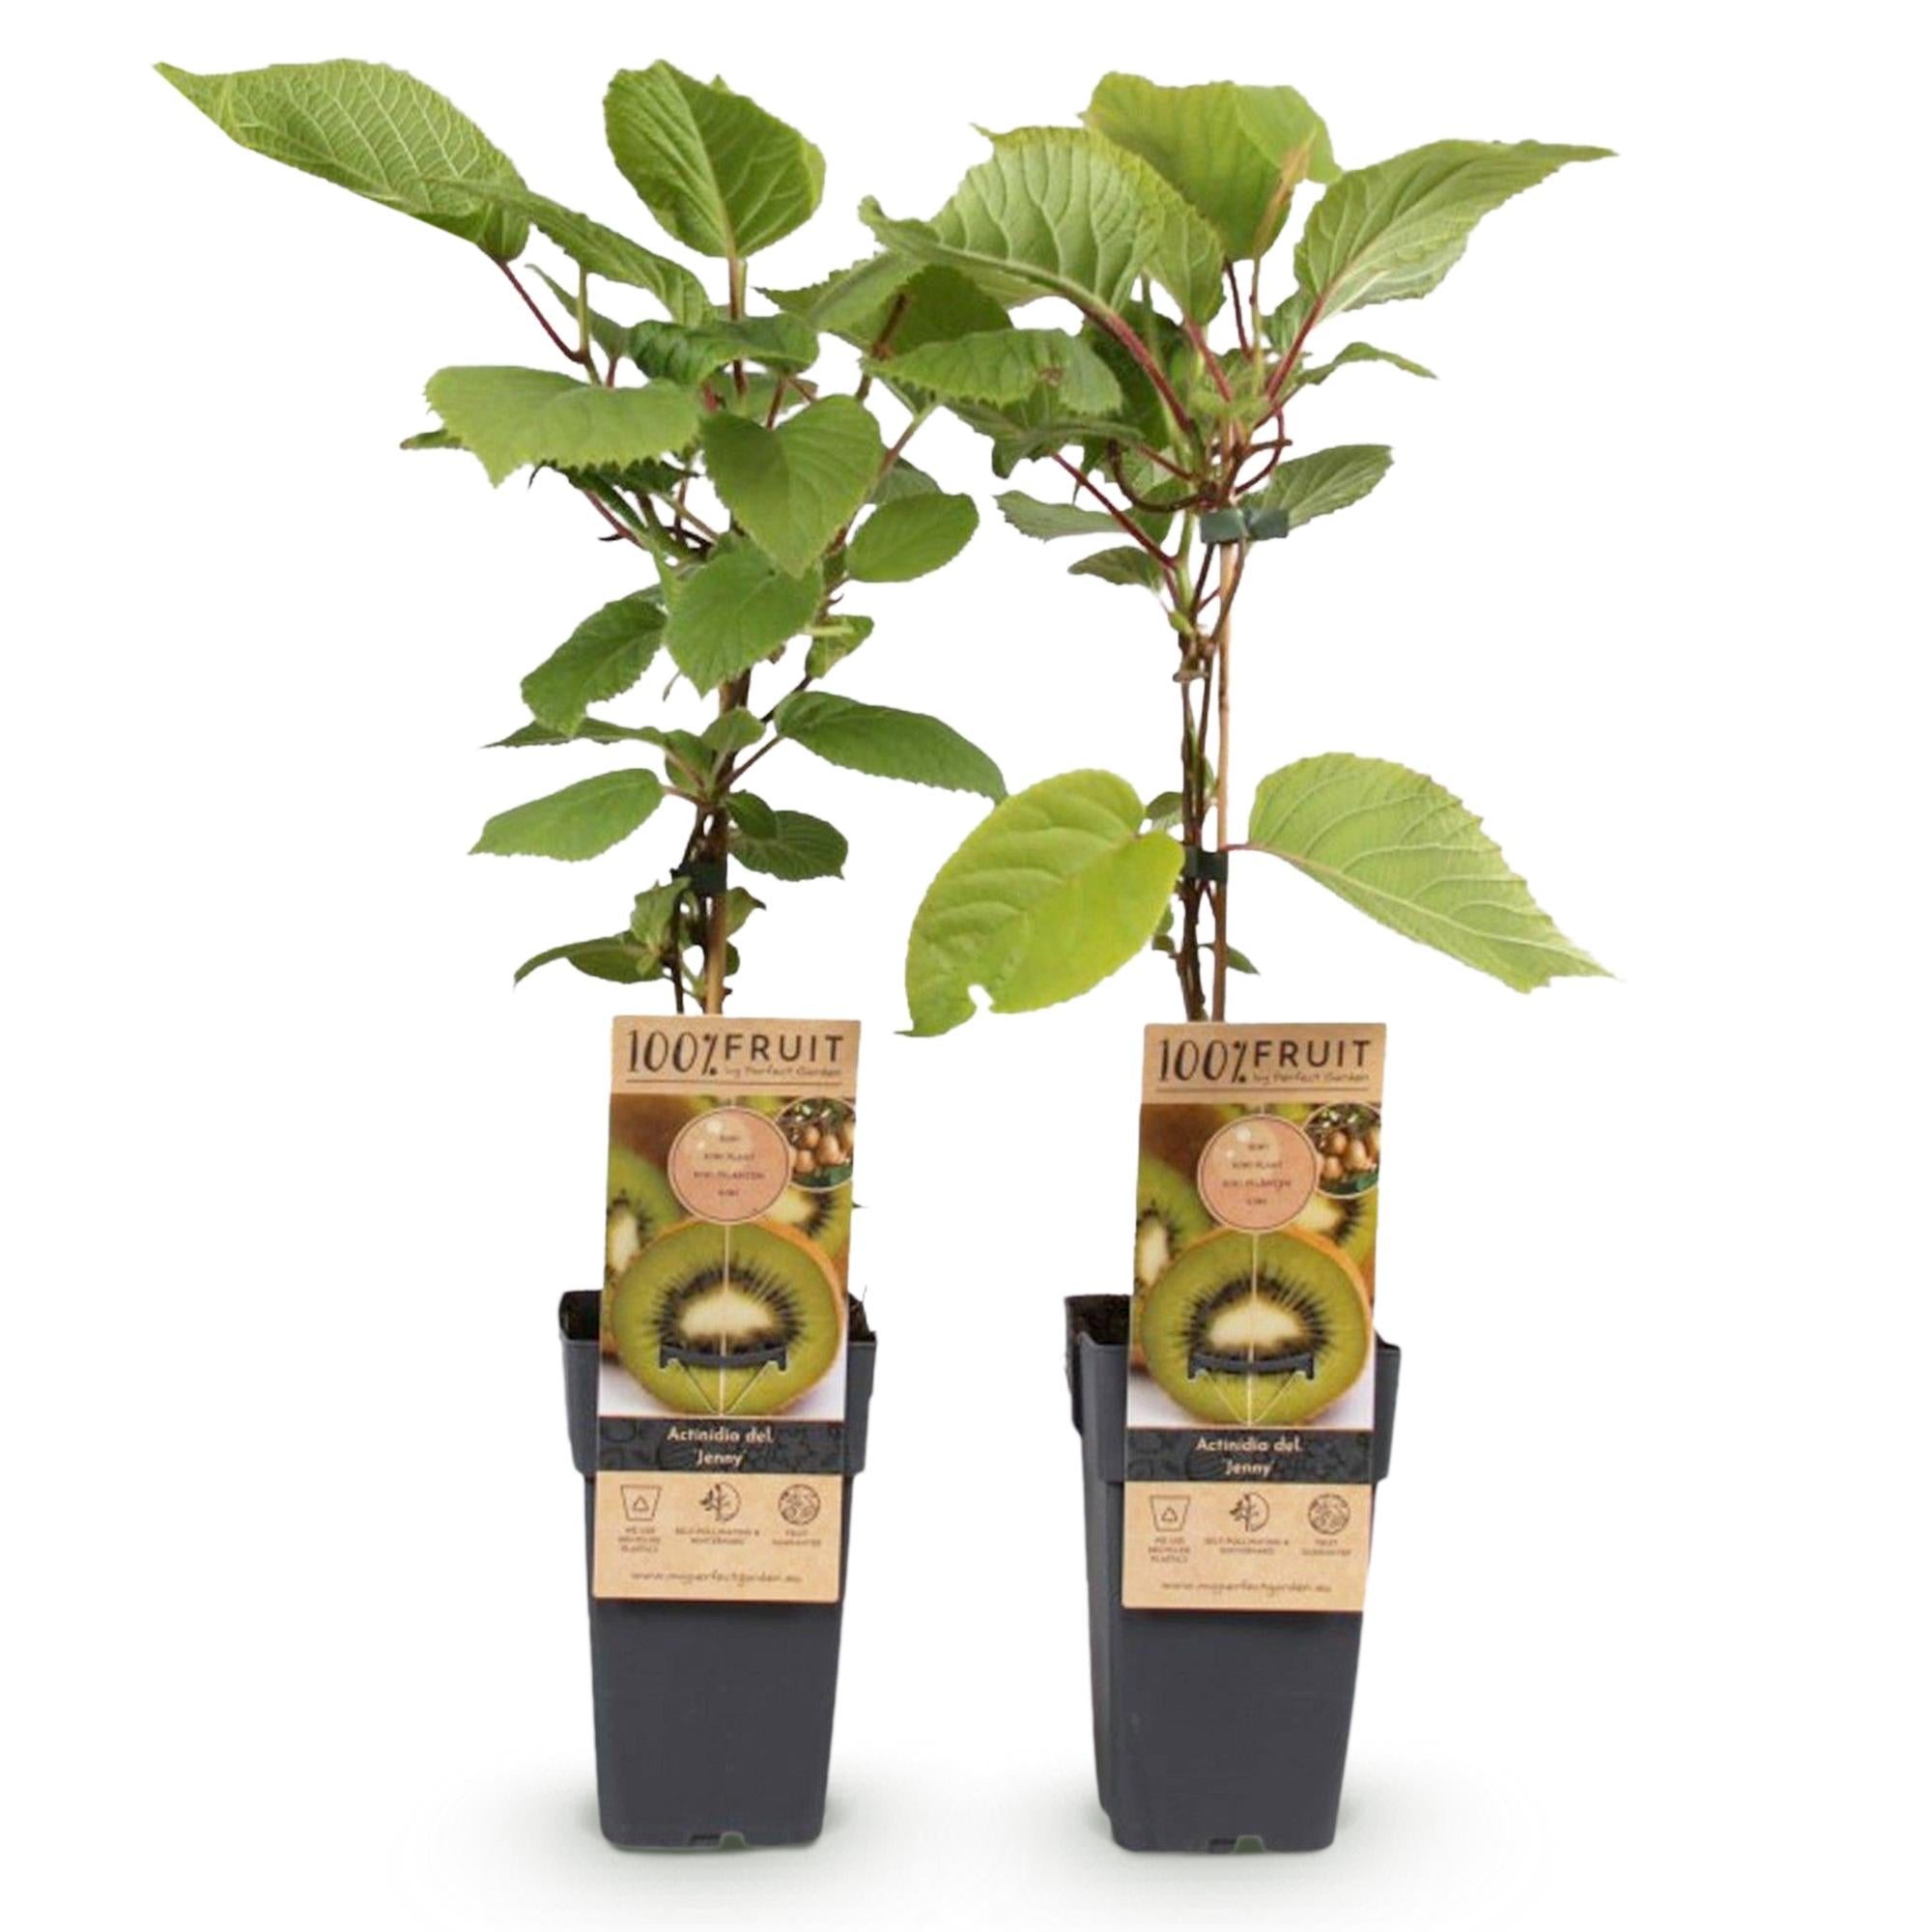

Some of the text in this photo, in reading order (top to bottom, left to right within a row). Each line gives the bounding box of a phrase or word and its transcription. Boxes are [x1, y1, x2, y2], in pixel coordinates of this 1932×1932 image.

[628, 1030, 844, 1076] 100% FRUIT
[1159, 1037, 1372, 1084] 100% FRUIT
[745, 1066, 792, 1077] Perfect
[1273, 1071, 1321, 1083] Perfect
[667, 1426, 740, 1443] Actinidia
[1195, 1435, 1269, 1453] Actinidia
